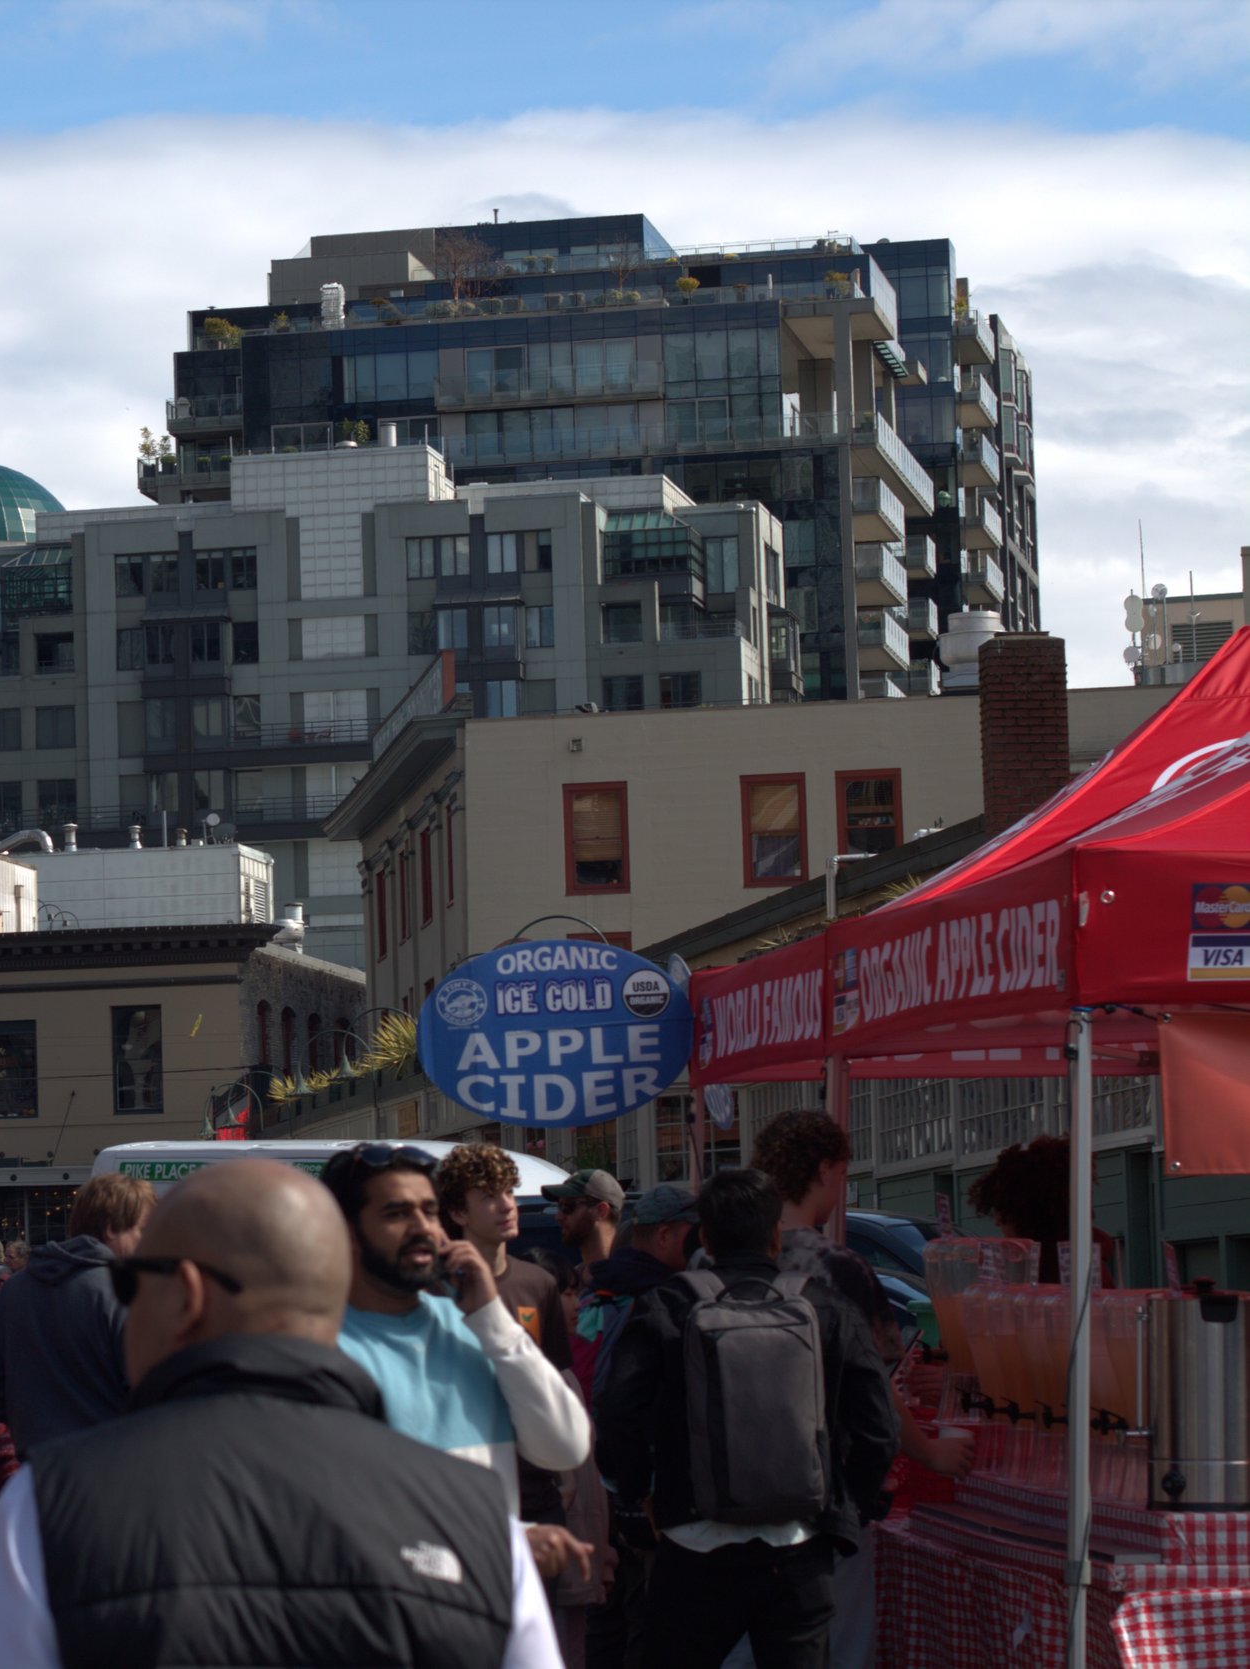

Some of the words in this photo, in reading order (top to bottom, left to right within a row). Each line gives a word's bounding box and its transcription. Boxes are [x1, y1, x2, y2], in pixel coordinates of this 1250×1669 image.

[496, 945, 618, 975] ORGANIC
[858, 926, 932, 1023] ORGANIC
[934, 912, 993, 1002] APPLE
[996, 898, 1061, 994] CIDER
[1203, 948, 1244, 966] VISA
[495, 980, 539, 1015] ICE
[545, 977, 613, 1013] COLD
[629, 995, 665, 1006] ORGANIC
[632, 981, 660, 992] USDA
[713, 983, 759, 1058] WORLD
[761, 968, 823, 1046] FAMOUS
[456, 1024, 662, 1071] APPLE
[456, 1066, 664, 1121] CIDER
[125, 1163, 151, 1179] PIKE
[154, 1163, 196, 1179] PLACE
